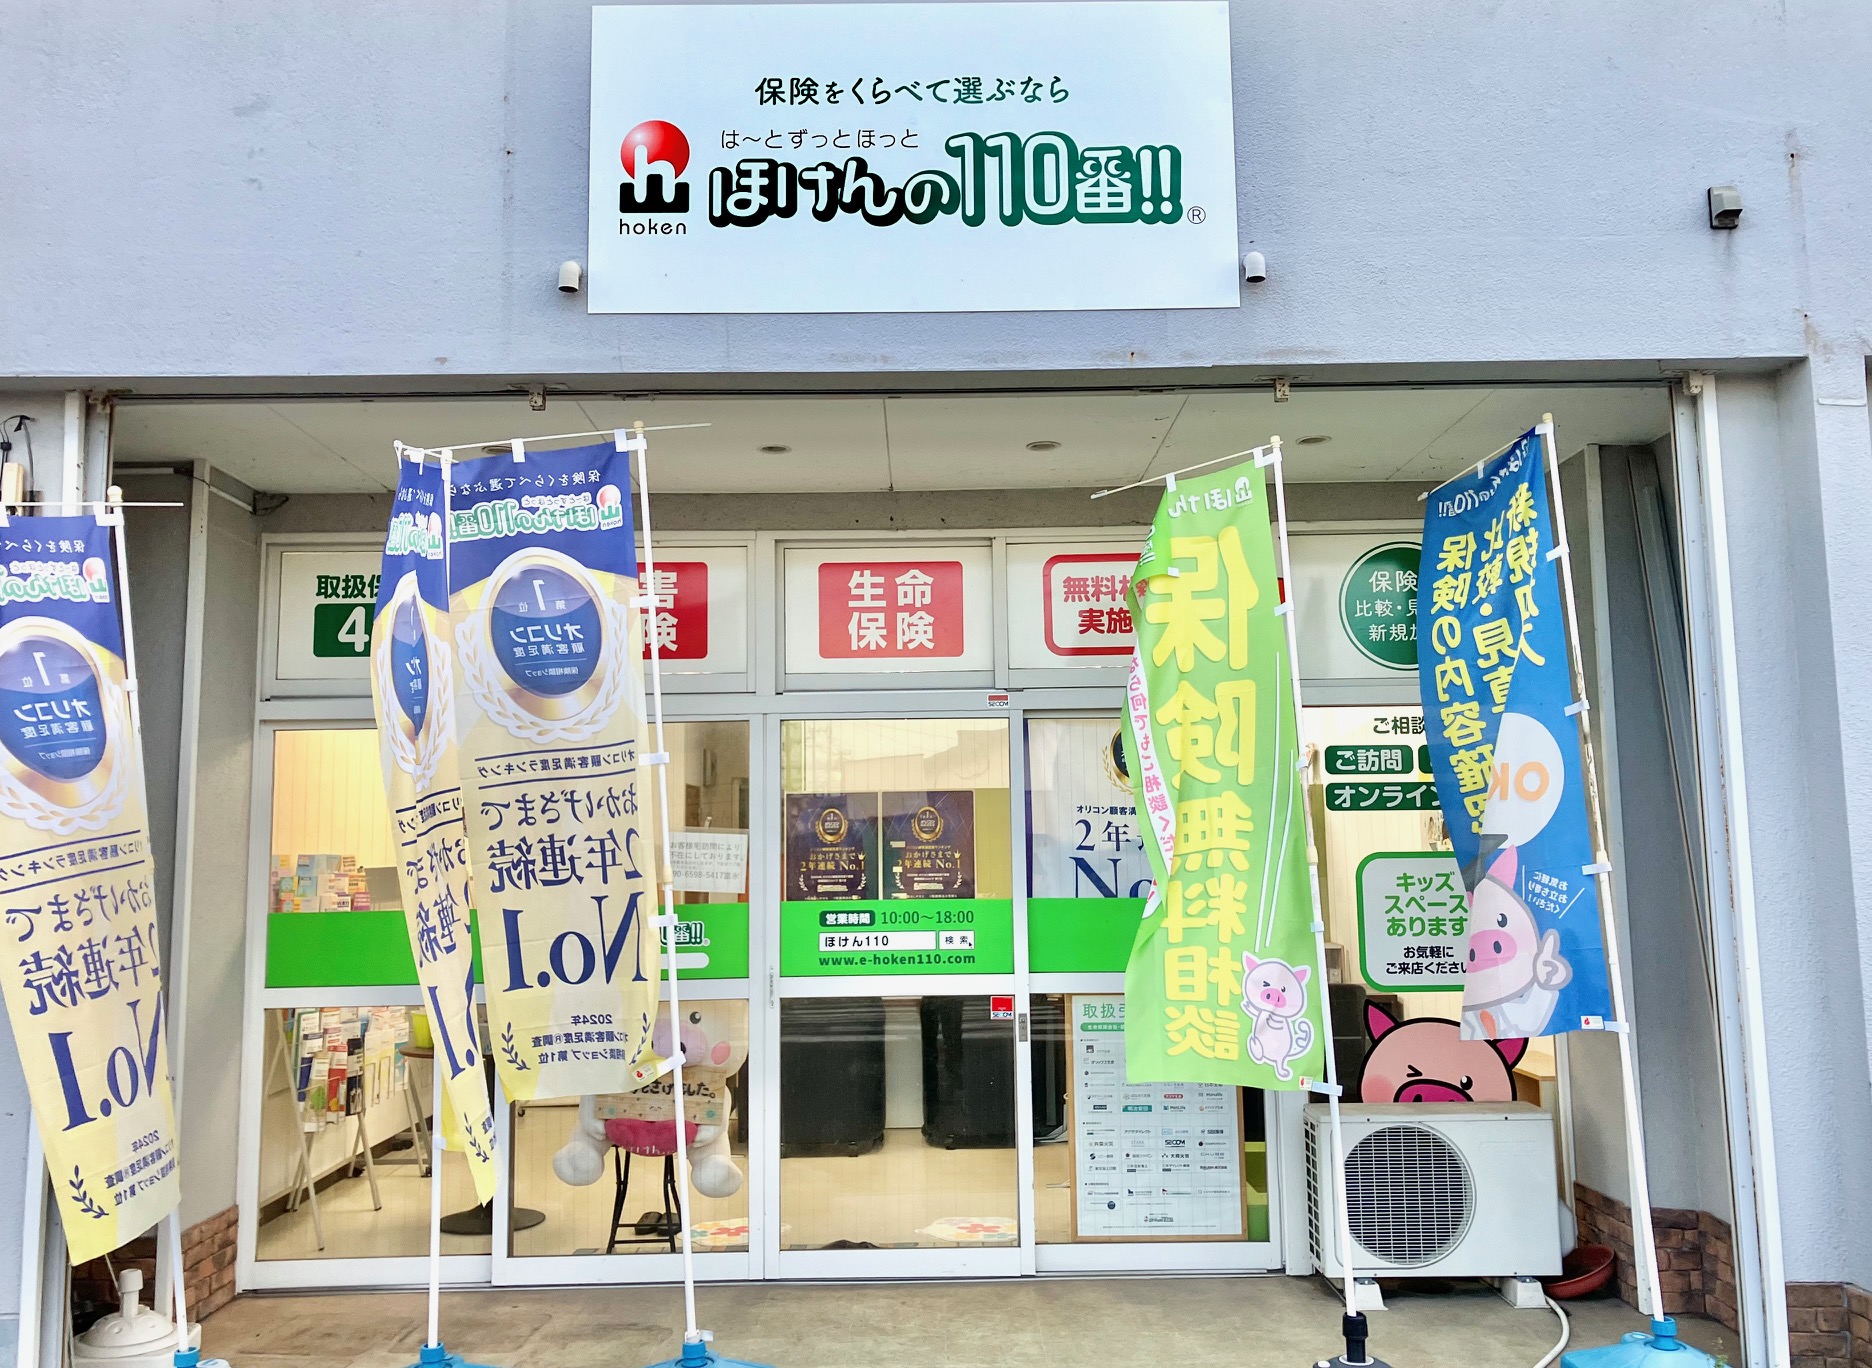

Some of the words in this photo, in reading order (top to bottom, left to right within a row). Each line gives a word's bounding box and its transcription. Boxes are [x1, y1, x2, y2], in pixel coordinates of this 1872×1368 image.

[754, 76, 1070, 106] 保険をくらべて選ぶなら
[708, 131, 1182, 227] ほけんの110番!!
[618, 218, 688, 236] hoken
[847, 569, 935, 608] 生命
[1368, 570, 1418, 593] 保険
[847, 611, 936, 651] 保険
[1336, 749, 1402, 772] ご訪問
[1075, 820, 1142, 851] 2年
[1395, 871, 1456, 893] キッズ
[1384, 895, 1469, 914] スペース
[825, 912, 871, 925] 営業時間
[1386, 916, 1469, 938] あります
[825, 935, 889, 948] ほけん110
[1403, 945, 1455, 960] お気軽に
[818, 953, 976, 966] www.e-hoken110.com
